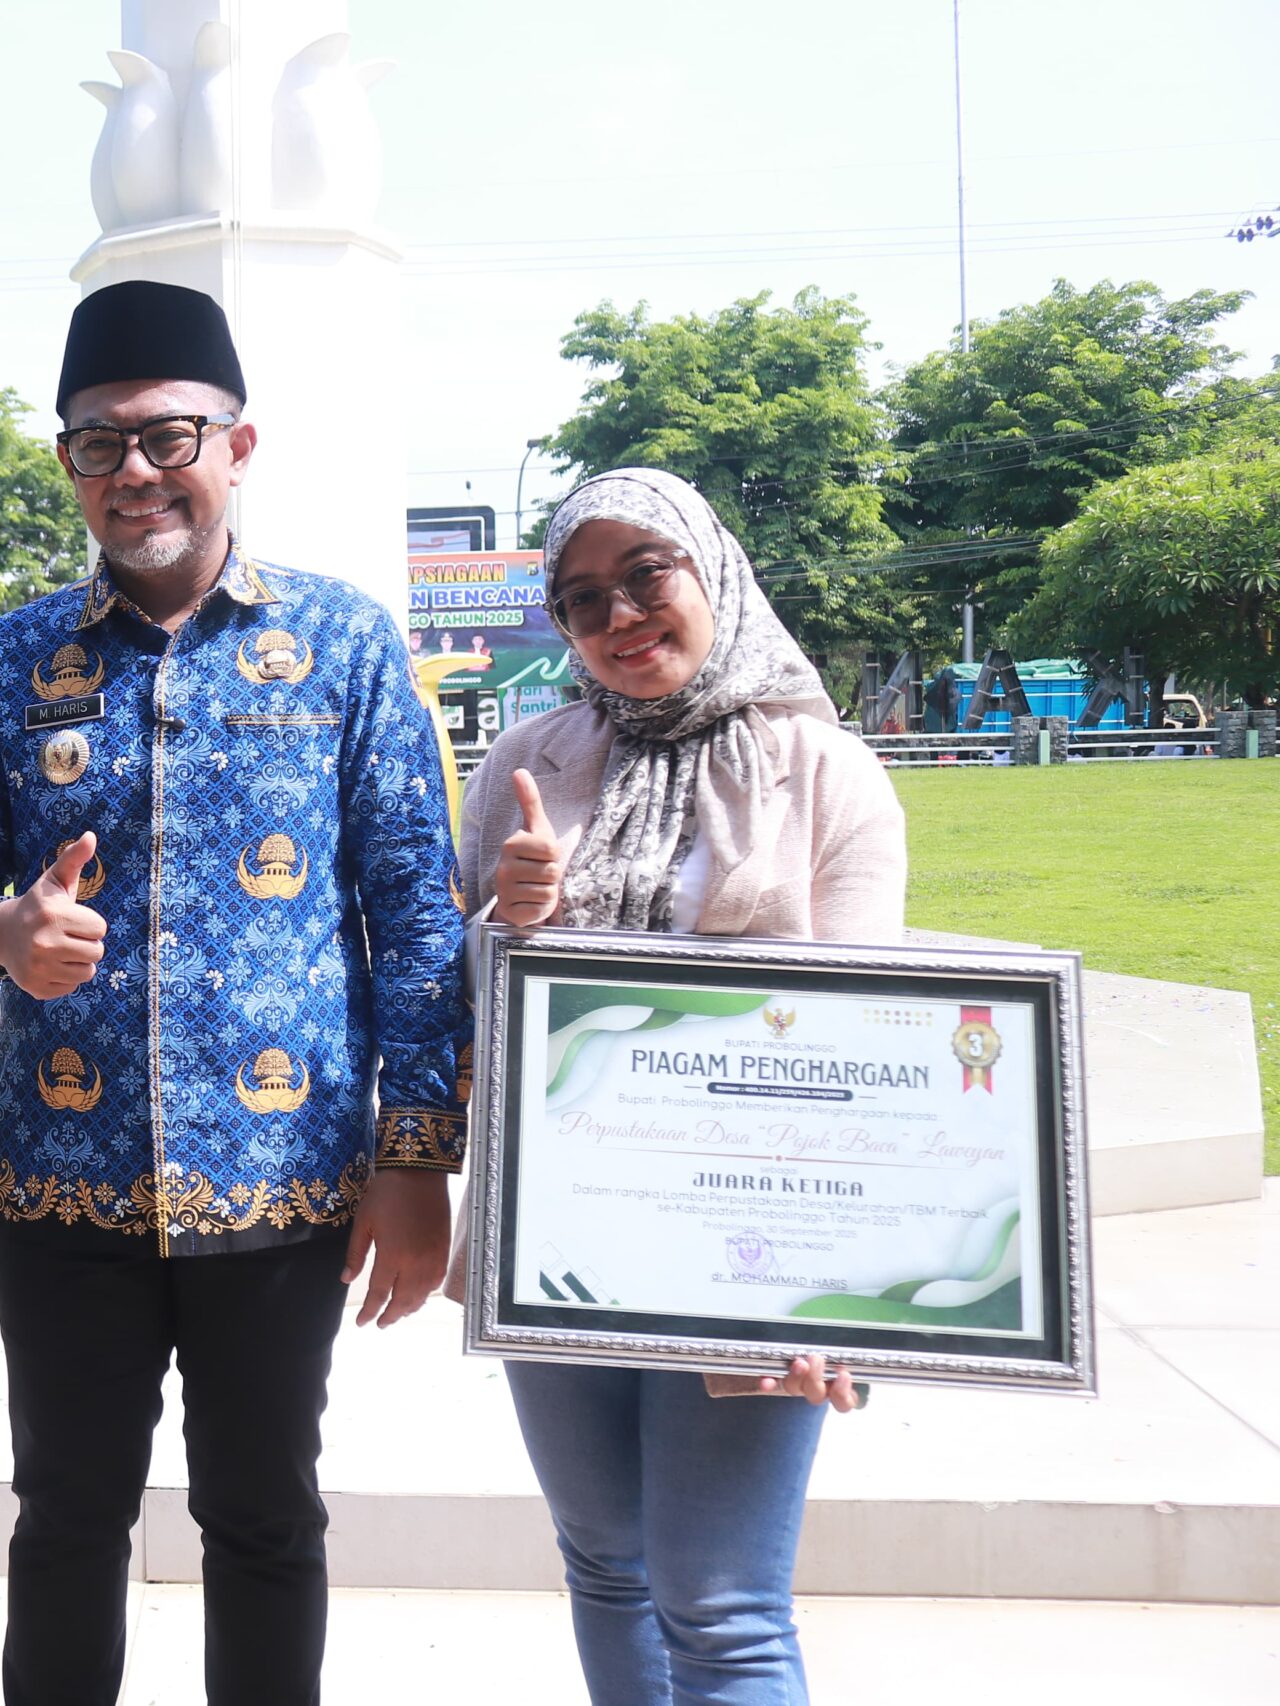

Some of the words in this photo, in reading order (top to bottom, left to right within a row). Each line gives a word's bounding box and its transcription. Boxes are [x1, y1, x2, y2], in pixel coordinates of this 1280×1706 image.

[435, 588, 545, 606] BENCANA
[433, 614, 483, 626] TAHUN
[486, 612, 522, 623] 2025
[39, 708, 51, 719] M.
[54, 701, 88, 717] HARIS
[725, 1039, 759, 1048] BUPATI
[763, 1041, 836, 1053] PROBOLINGGO
[968, 1033, 982, 1056] 3
[631, 1049, 727, 1077] PIAGAM
[741, 1055, 929, 1089] PENGHARGAAN
[618, 1093, 655, 1106] Bupati
[661, 1096, 732, 1111] Probolinggo
[736, 1100, 807, 1113] Memberikan
[811, 1105, 889, 1119] Penghargaan
[557, 1110, 686, 1149] Perpustakaan
[694, 1118, 750, 1146] Desa
[759, 1164, 797, 1175] sebagai
[692, 1172, 772, 1191] JUARA
[782, 1177, 863, 1197] KETIGA
[572, 1183, 611, 1196] Dalam
[615, 1186, 659, 1201] rangka
[663, 1189, 706, 1202] Lomba
[709, 1192, 796, 1209] Perpustakaan
[940, 1206, 988, 1219] Terbaik
[657, 1202, 744, 1218] se-Kabupaten
[748, 1207, 825, 1224] Probolinggo
[830, 1212, 869, 1224] Tahun
[873, 1215, 900, 1227] 2025
[732, 1273, 806, 1286] MOHAMMAD
[812, 1278, 847, 1289] HARIS
